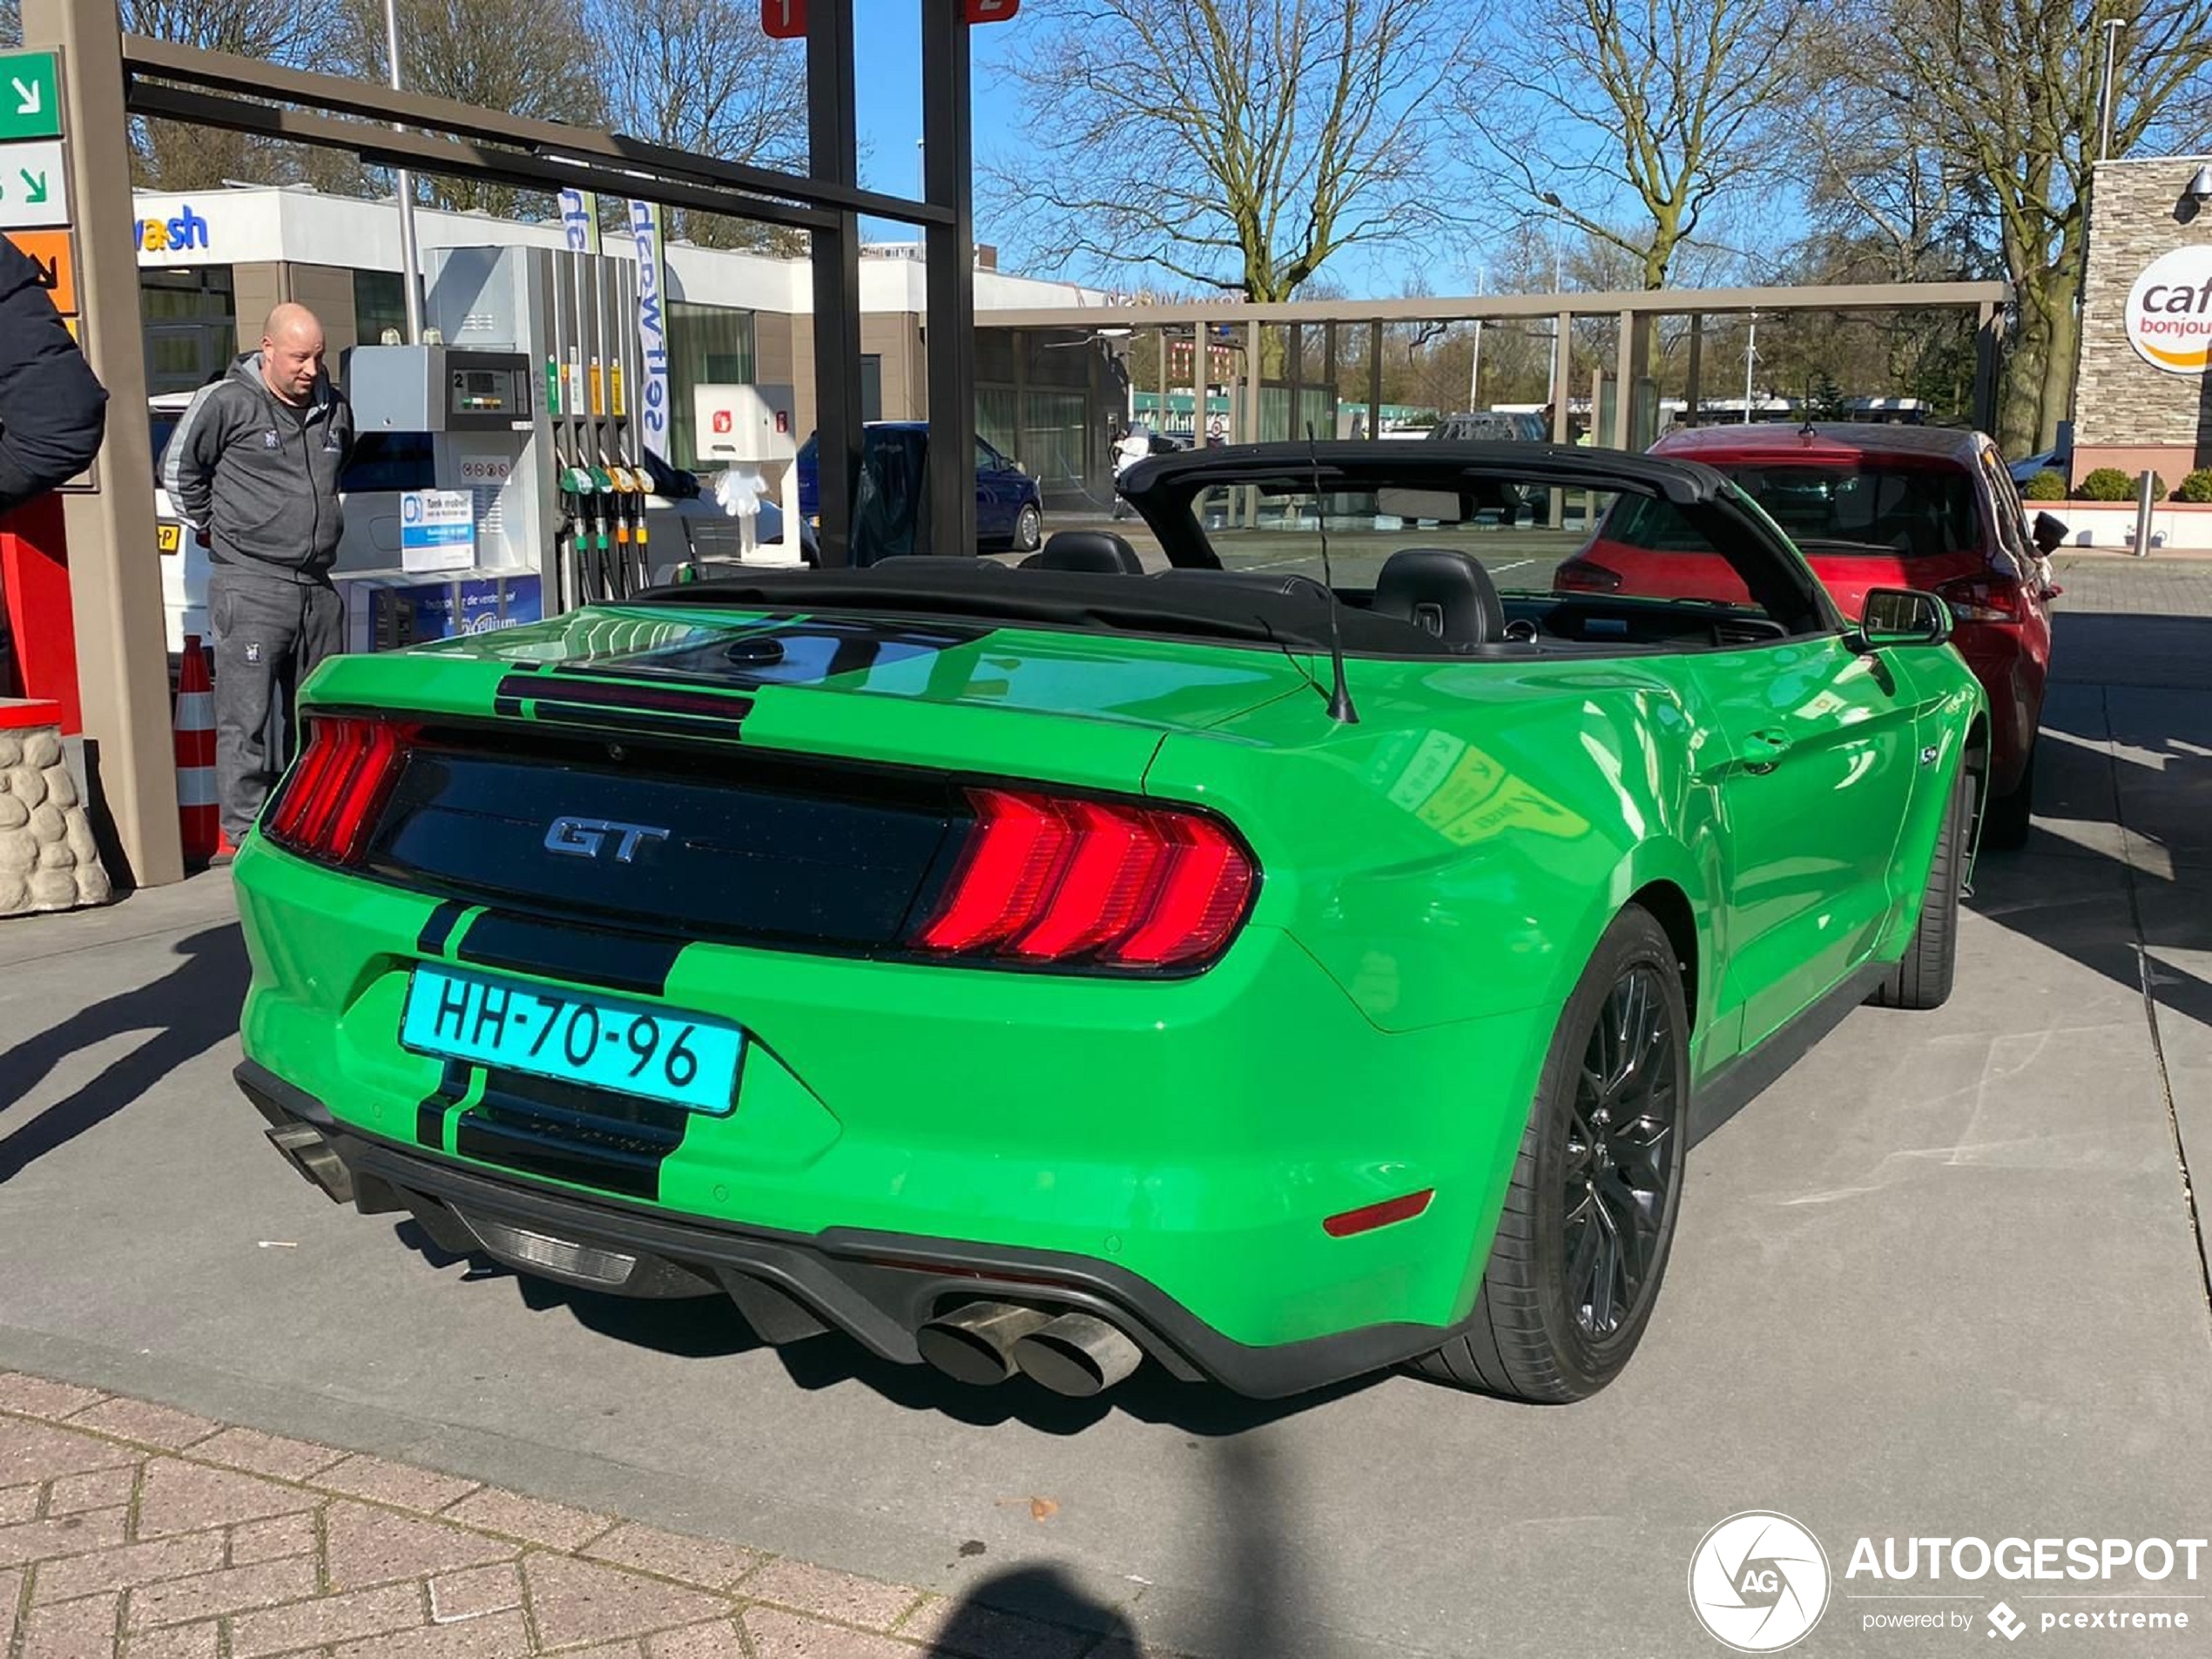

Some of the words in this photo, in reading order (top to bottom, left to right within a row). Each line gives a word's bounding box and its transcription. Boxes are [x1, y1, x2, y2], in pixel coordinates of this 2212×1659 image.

[455, 373, 463, 388] 2
[543, 816, 671, 863] GT
[434, 978, 699, 1088] HH-70-96
